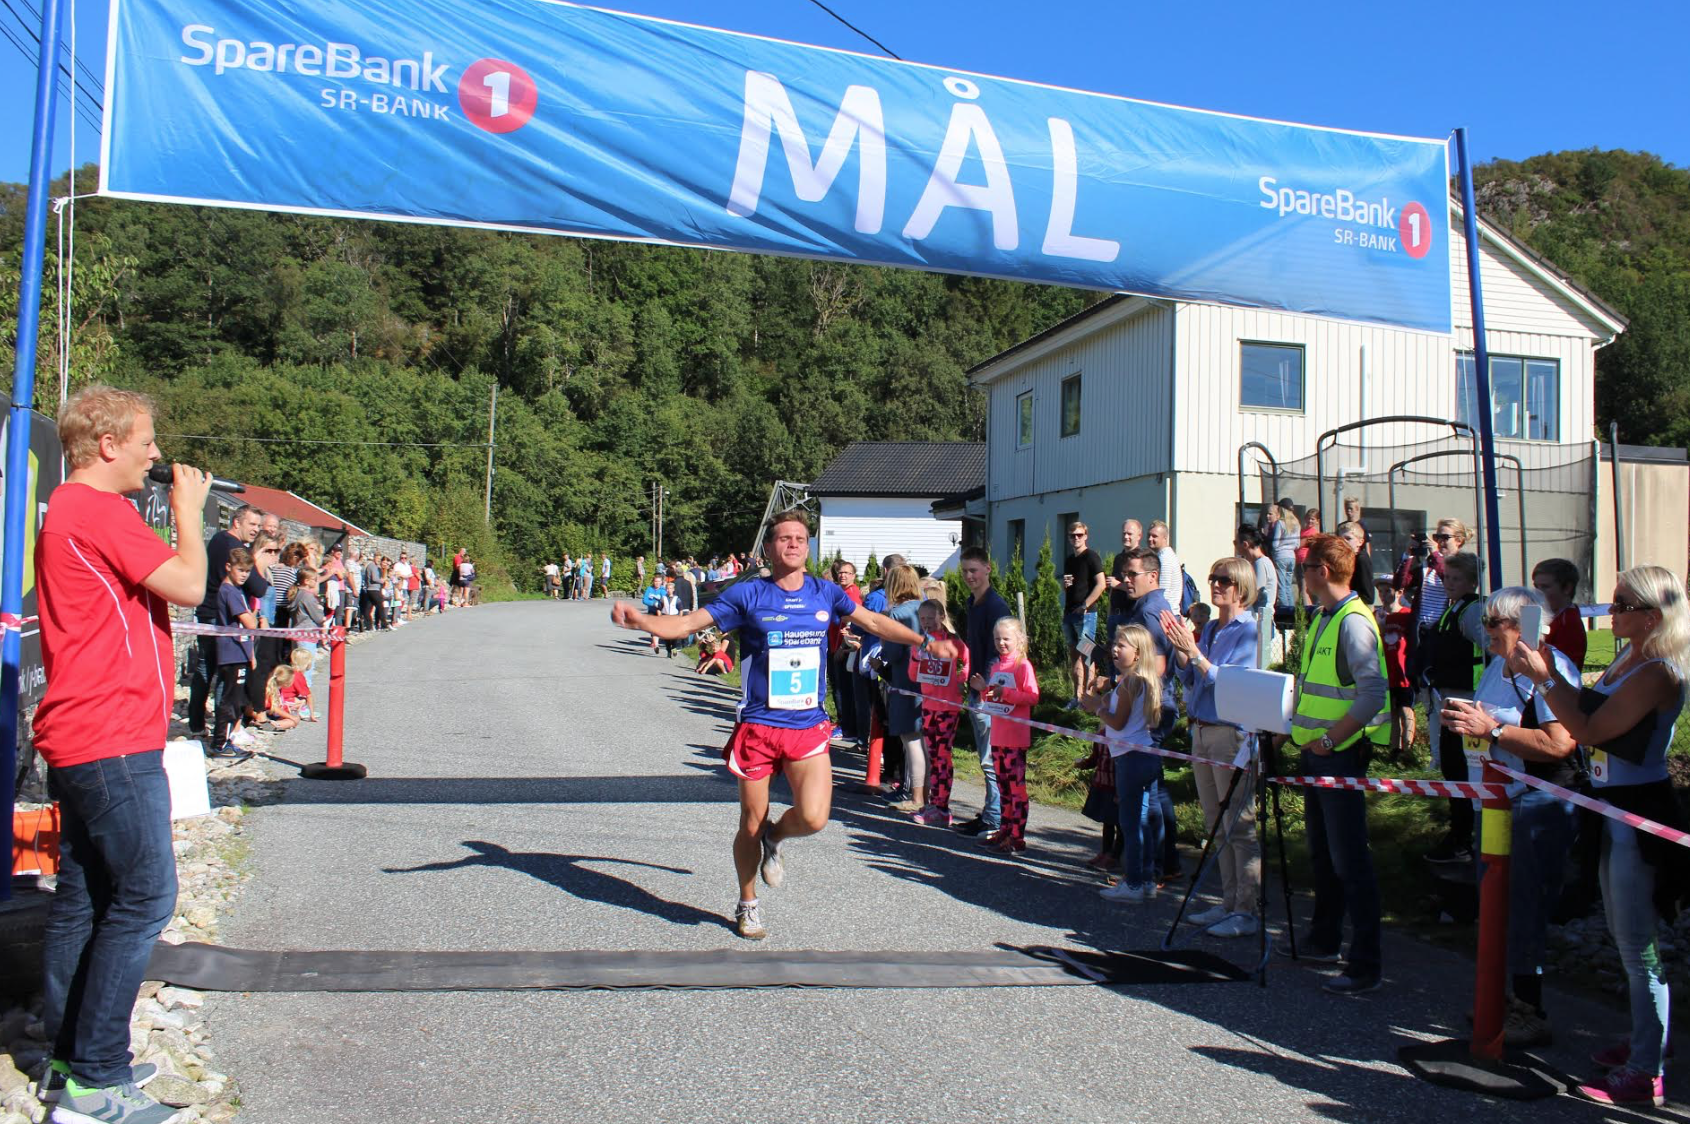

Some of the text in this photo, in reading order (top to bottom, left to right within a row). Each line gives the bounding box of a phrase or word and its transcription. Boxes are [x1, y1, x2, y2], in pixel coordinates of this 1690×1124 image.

[181, 24, 511, 118] SpareBank 1
[321, 88, 450, 121] SR-BANK
[726, 70, 1120, 262] MÅL
[1258, 176, 1420, 248] SpareBank 1
[1334, 228, 1396, 252] SR-BANK
[784, 630, 826, 639] Haugesund
[790, 672, 802, 693] 5
